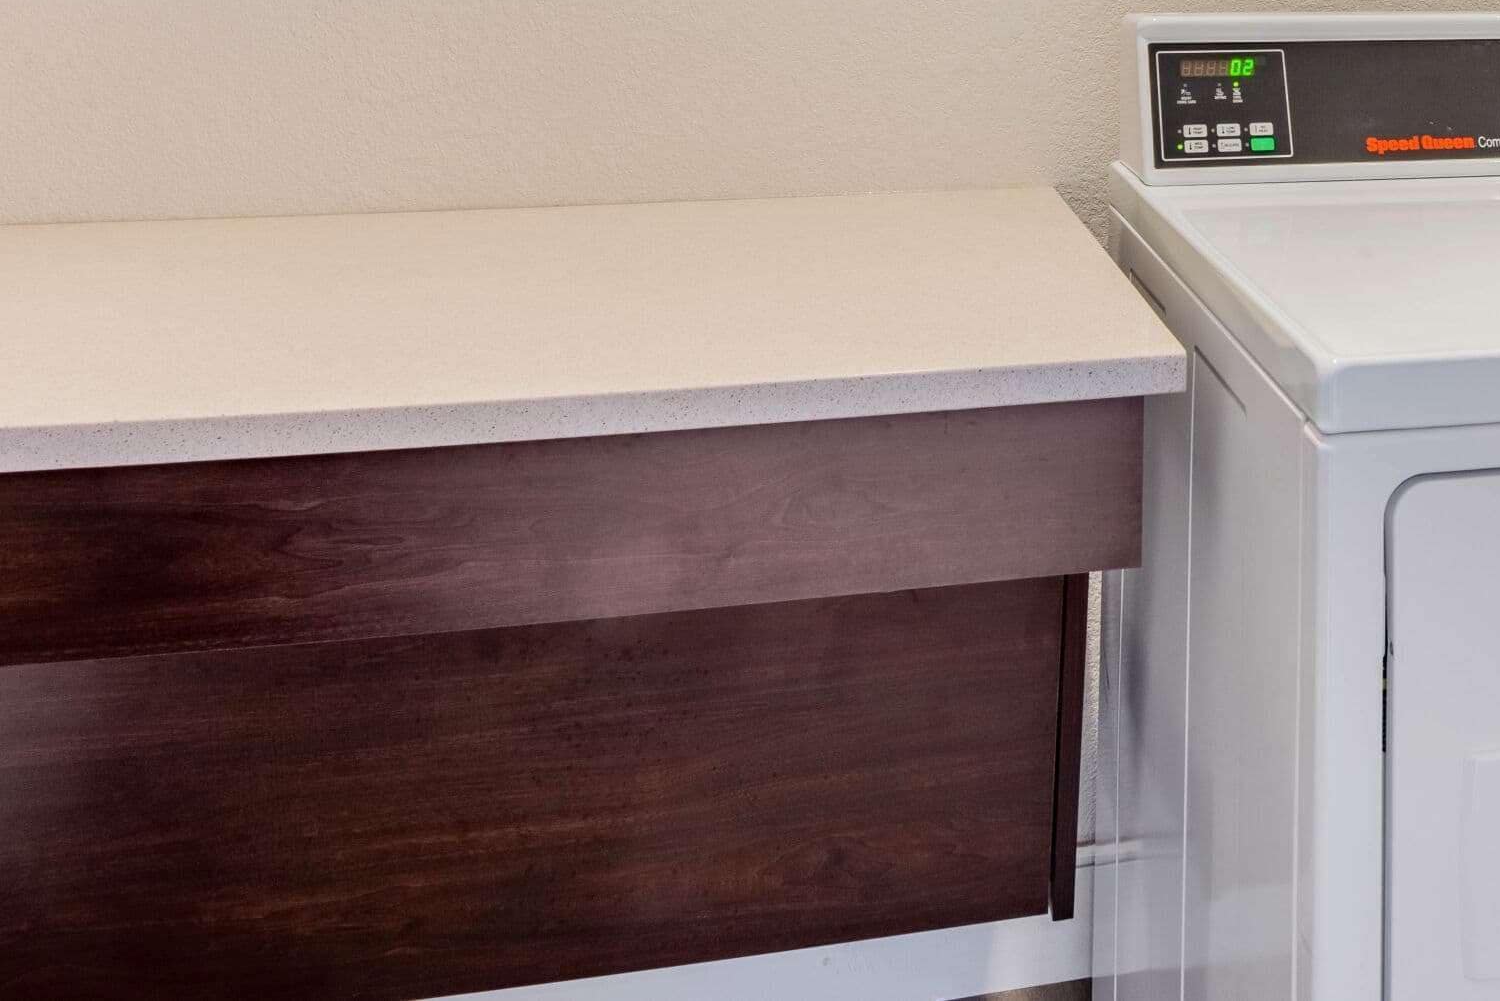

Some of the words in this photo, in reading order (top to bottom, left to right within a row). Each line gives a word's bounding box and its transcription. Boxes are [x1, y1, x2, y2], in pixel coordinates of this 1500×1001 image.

[1230, 59, 1254, 76] 02
[1366, 135, 1419, 154] Speed
[1421, 134, 1475, 150] Queen
